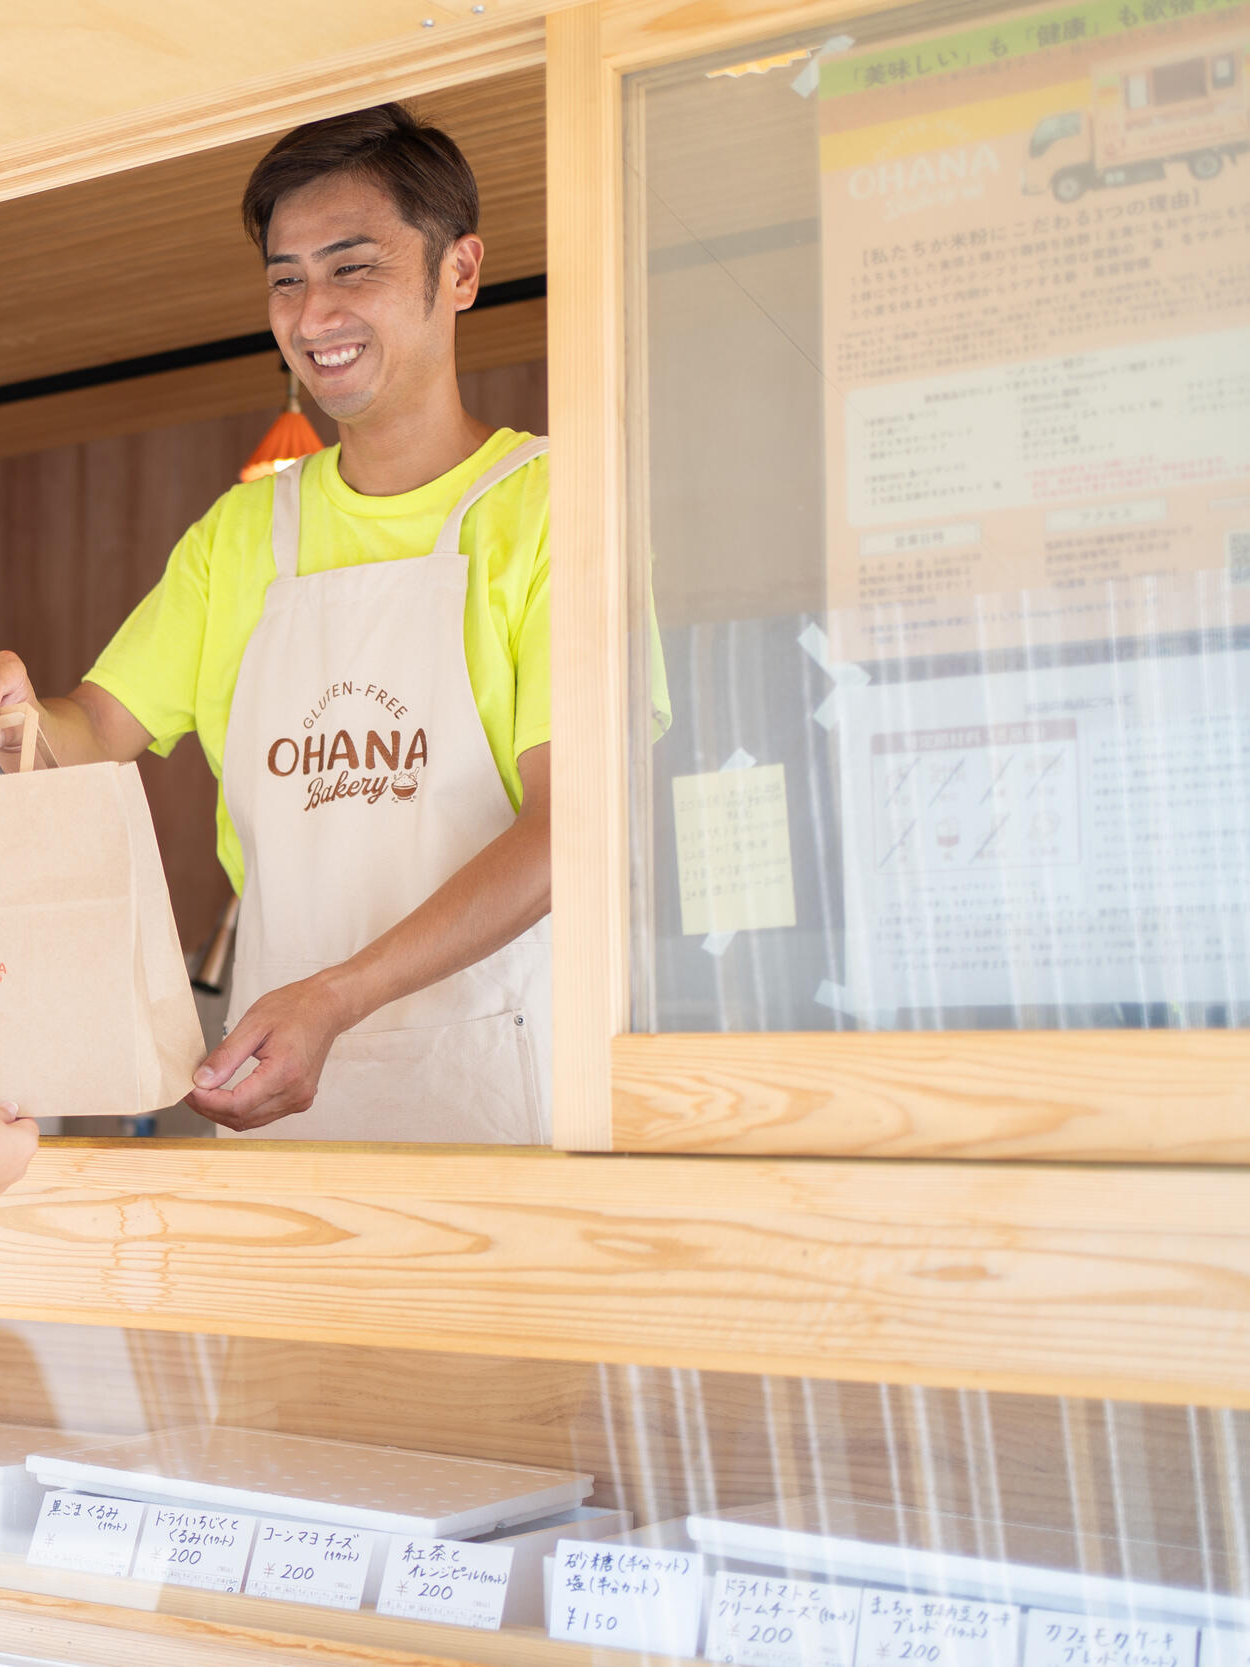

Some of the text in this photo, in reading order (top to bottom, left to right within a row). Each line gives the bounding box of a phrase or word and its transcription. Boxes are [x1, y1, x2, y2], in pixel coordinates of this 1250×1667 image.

[848, 143, 1000, 200] OHANA
[303, 681, 408, 729] GLUTEN-FREE
[267, 728, 428, 777] OHANA
[304, 770, 388, 811] Bakery
[401, 1541, 461, 1562] 紅茶と
